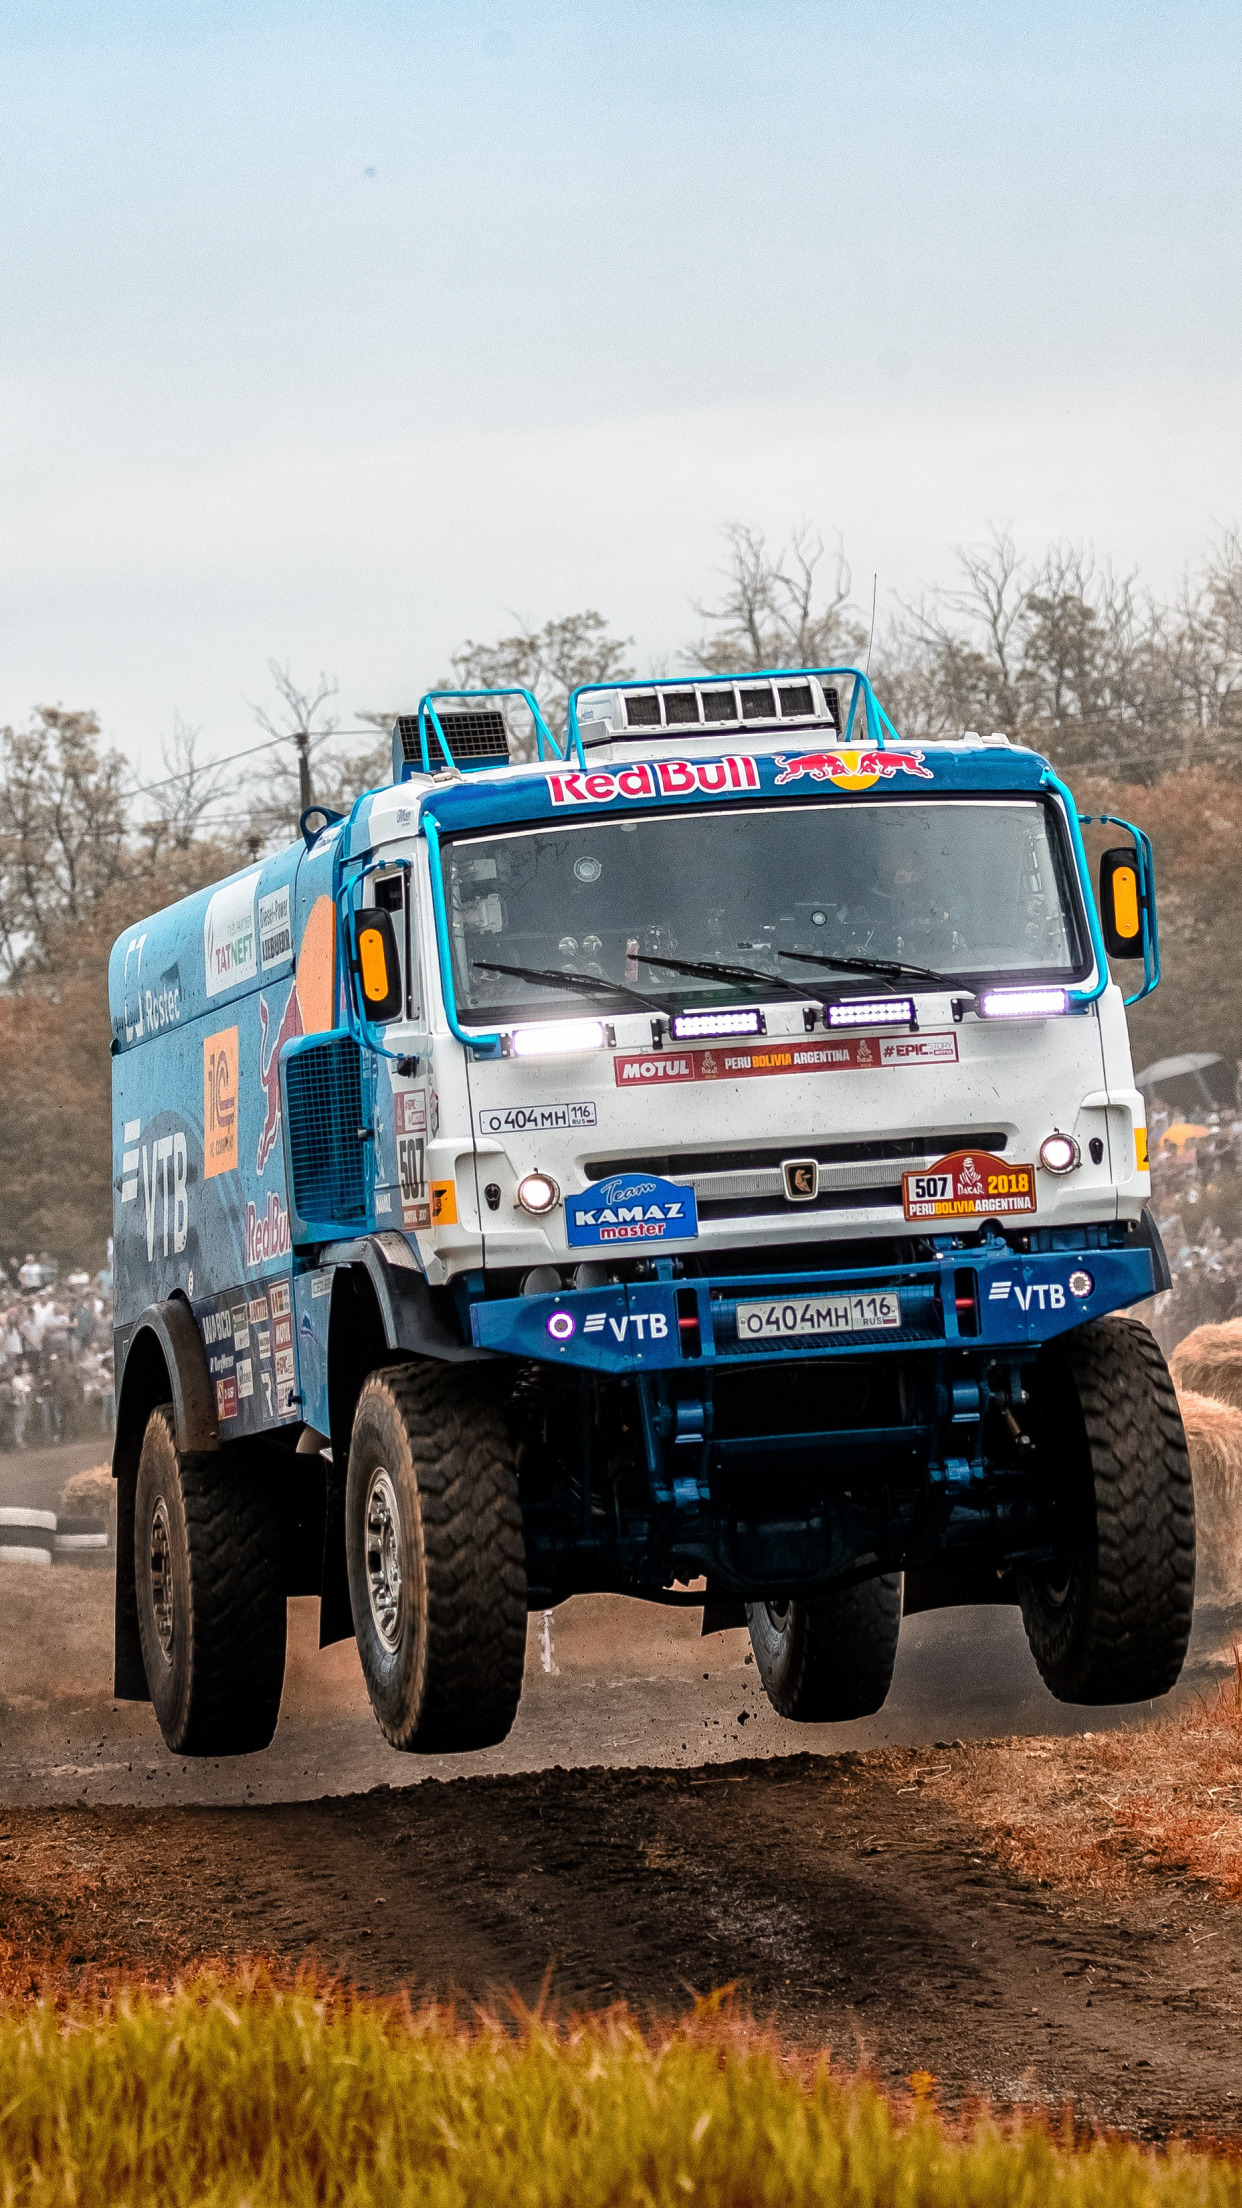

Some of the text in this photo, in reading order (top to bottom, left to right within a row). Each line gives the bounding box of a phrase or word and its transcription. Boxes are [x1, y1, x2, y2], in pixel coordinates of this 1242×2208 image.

[547, 756, 757, 802] Red Bull
[215, 932, 252, 975] TATNEFT
[145, 982, 180, 1033] Rostec
[724, 1049, 850, 1070] PERU BOLIVIA ARGENTINA
[883, 1041, 952, 1058] #EPIC STORY
[622, 1059, 690, 1079] MOTUL
[571, 1105, 591, 1118] 116
[399, 1138, 425, 1200] 507
[142, 1131, 188, 1262] VTB
[601, 1179, 656, 1205] Team
[915, 1176, 948, 1199] 507
[987, 1173, 1029, 1195] 2018
[575, 1202, 684, 1226] KAMAZ
[601, 1223, 666, 1240] master
[854, 1297, 891, 1319] 116
[1014, 1284, 1066, 1311] VTB
[202, 1309, 232, 1345] WABCO
[609, 1313, 669, 1342] VTB
[862, 1317, 882, 1326] RUS
